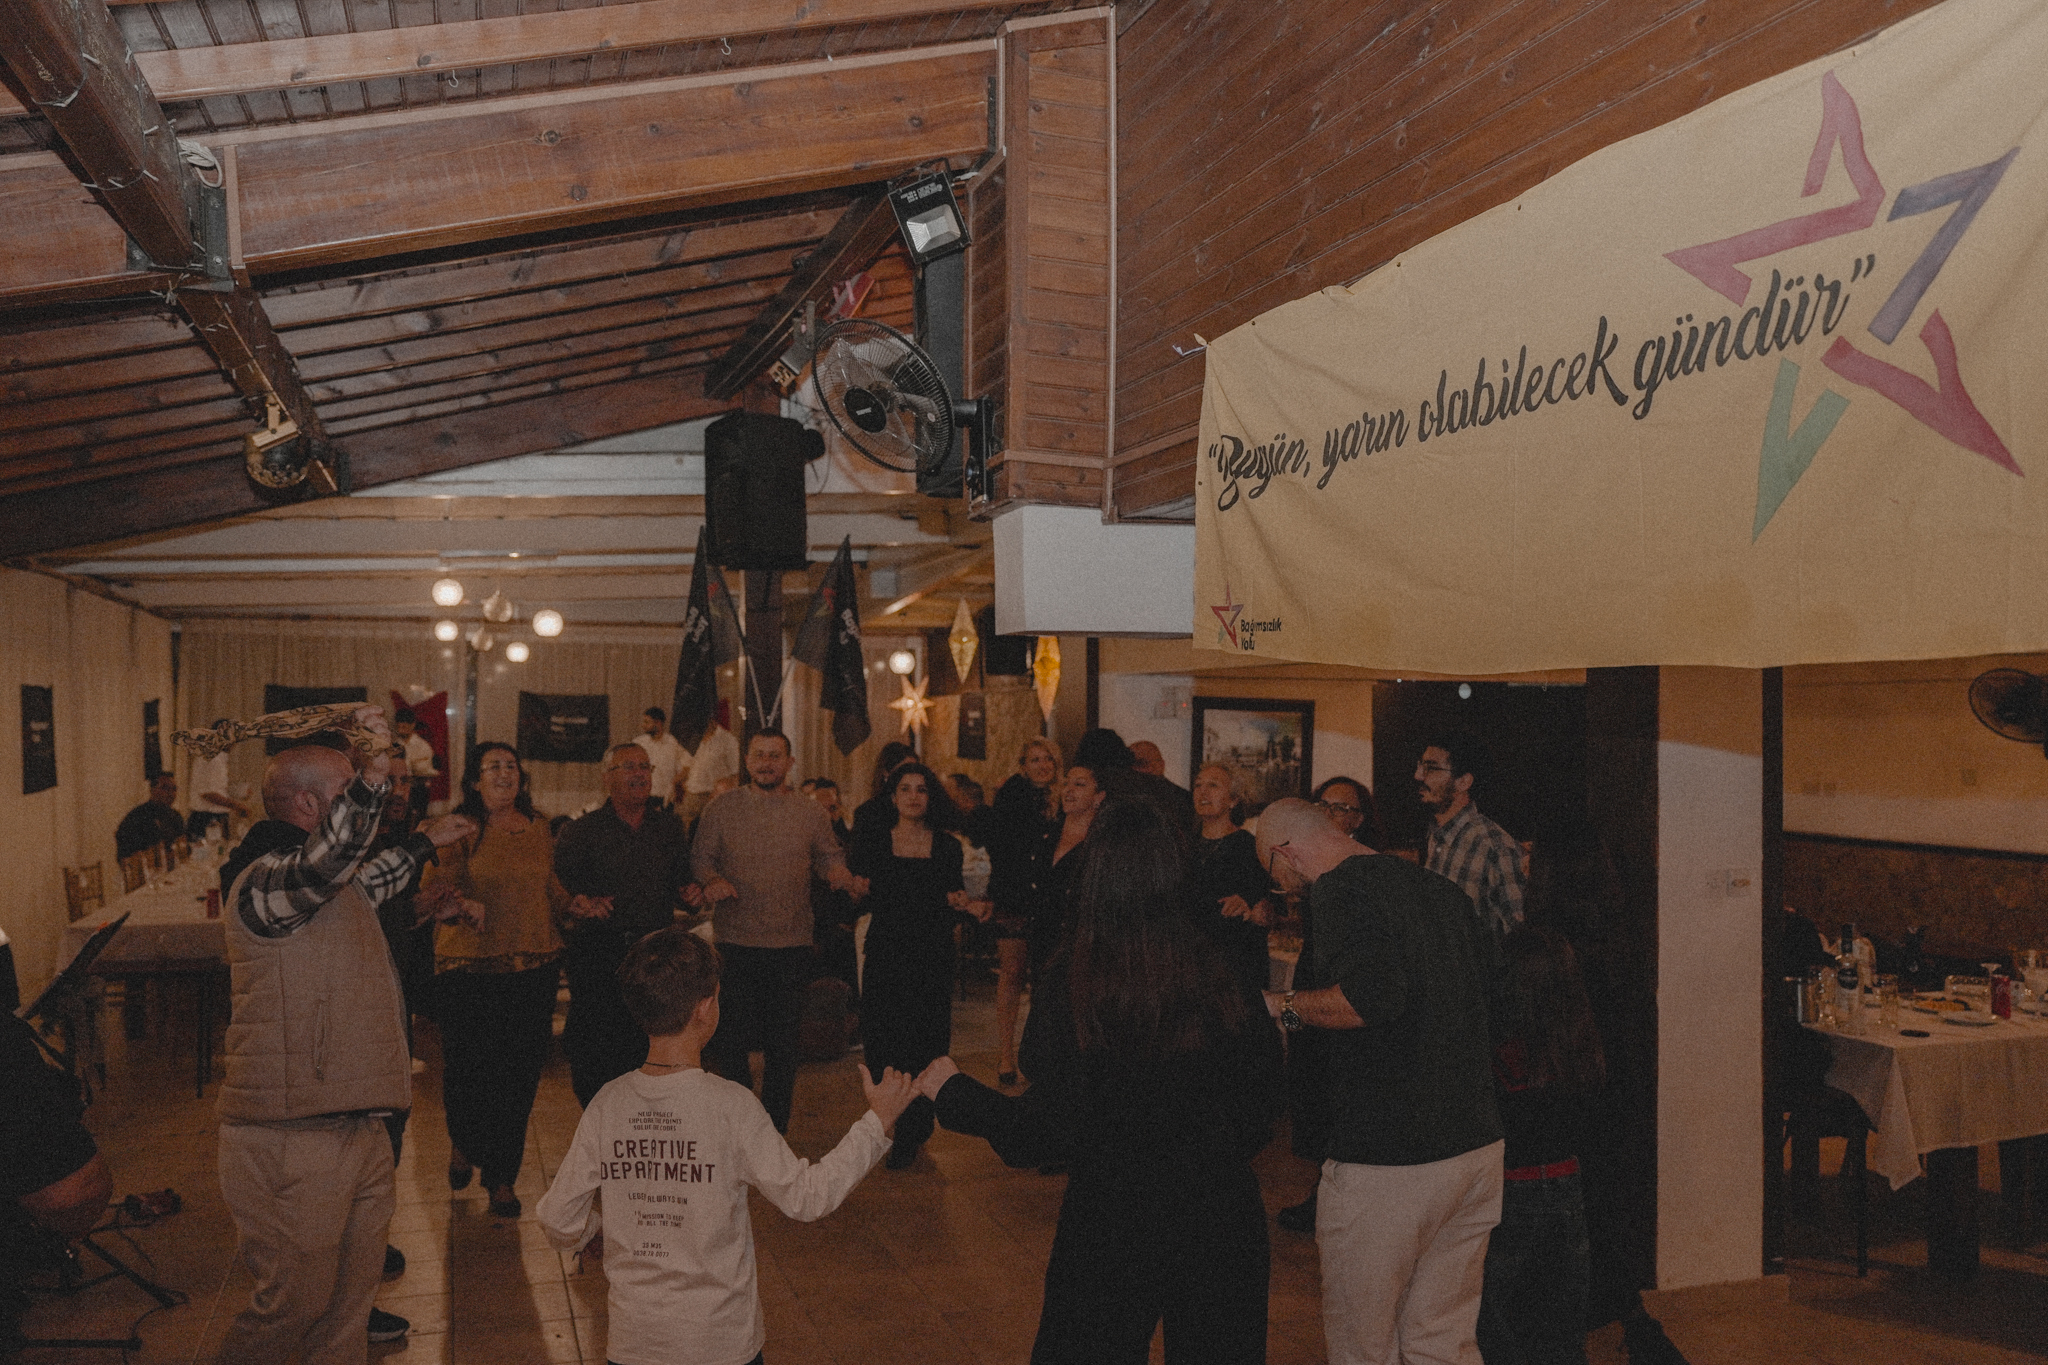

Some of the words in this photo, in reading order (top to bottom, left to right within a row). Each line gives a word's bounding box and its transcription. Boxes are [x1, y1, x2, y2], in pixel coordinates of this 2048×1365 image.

[1316, 408, 1410, 490] yarın
[1417, 315, 1629, 442] olabilecek
[1241, 637, 1255, 651] Yolu
[613, 1139, 697, 1160] CREATIVE
[600, 1161, 715, 1183] DEPARTMENT
